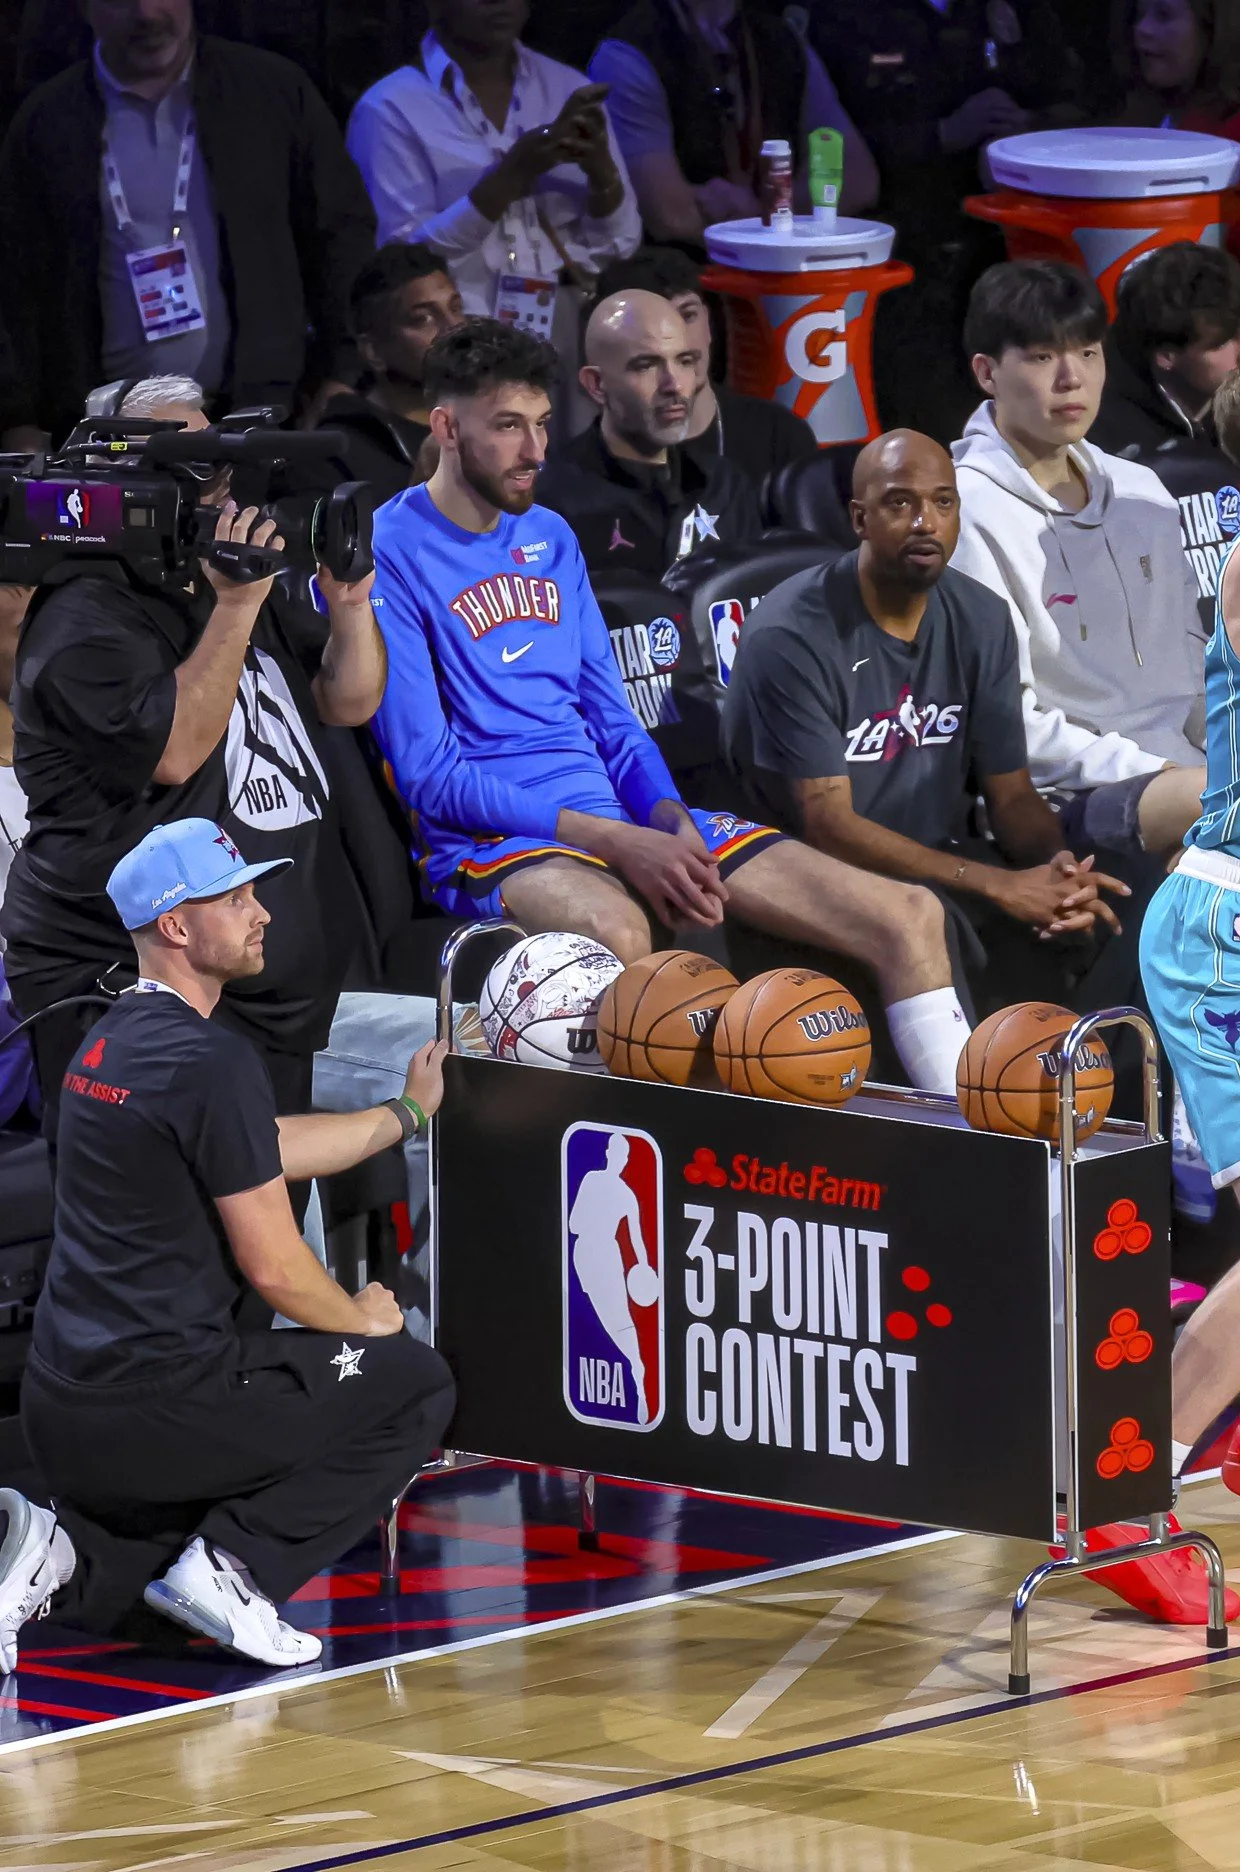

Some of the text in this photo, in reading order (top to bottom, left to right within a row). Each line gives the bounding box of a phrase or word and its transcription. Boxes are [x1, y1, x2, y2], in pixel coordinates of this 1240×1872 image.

[784, 309, 847, 383] G
[450, 574, 561, 640] THUNDER
[843, 703, 963, 762] LA 26
[242, 773, 289, 816] NBA
[86, 1081, 131, 1104] ASSIST
[683, 1203, 889, 1344] 3-POINT
[579, 1356, 626, 1408] NBA
[686, 1321, 917, 1467] CONTEST
